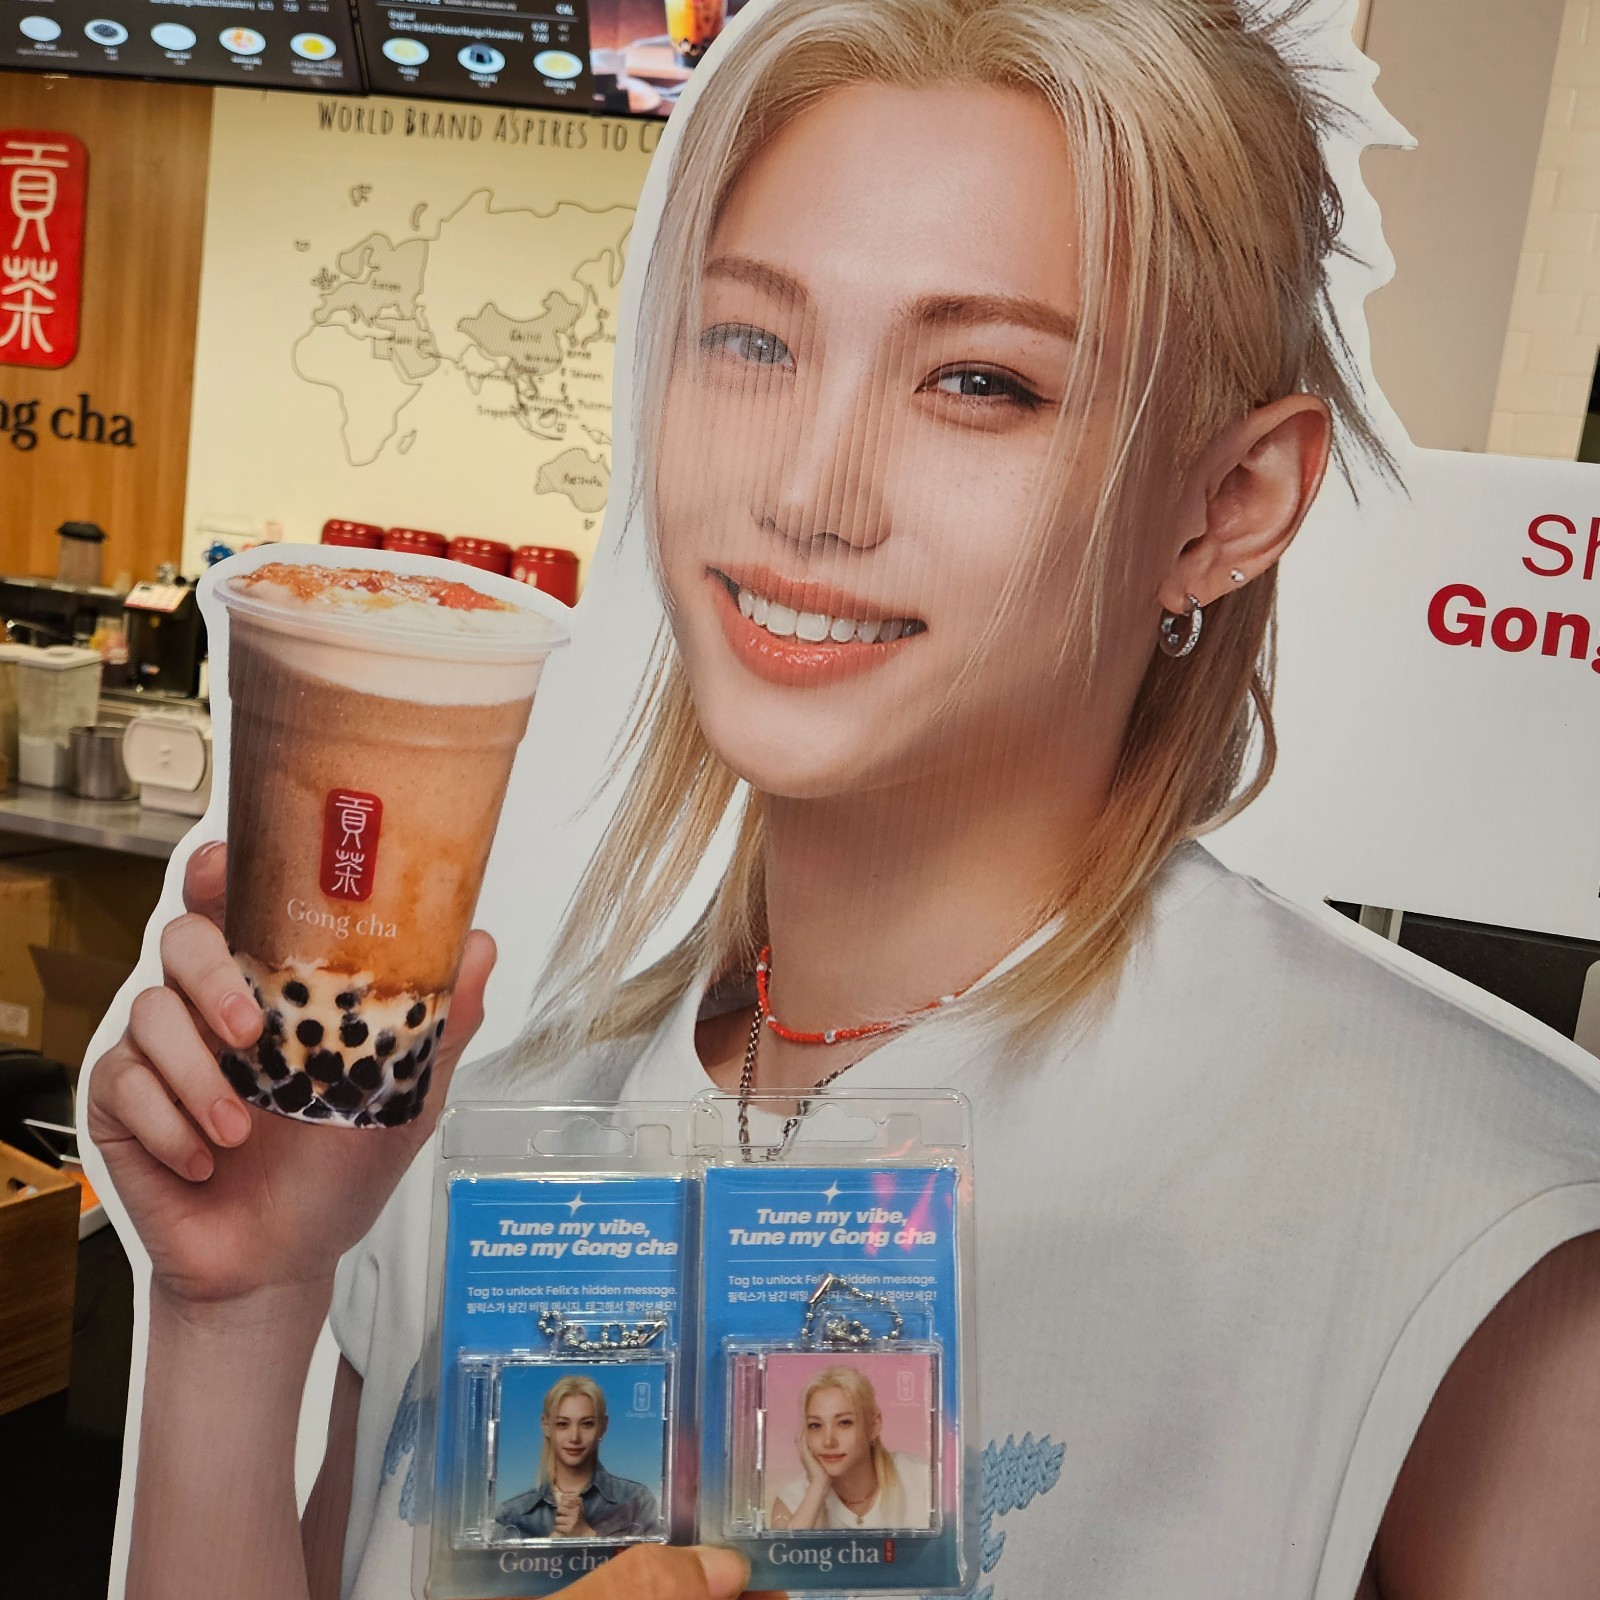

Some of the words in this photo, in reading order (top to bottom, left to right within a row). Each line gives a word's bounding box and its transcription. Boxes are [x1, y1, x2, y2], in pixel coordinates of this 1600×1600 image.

[318, 100, 394, 136] WORLD
[403, 106, 482, 142] BRAND
[495, 112, 588, 150] ASPIRES
[601, 122, 628, 152] TO
[51, 393, 136, 447] cha
[331, 795, 374, 896] 貢茶
[287, 897, 351, 940] Gong
[356, 913, 398, 939] cha
[499, 1219, 554, 1235] Tune
[558, 1222, 595, 1238] my
[599, 1218, 650, 1238] vibe,
[757, 1208, 812, 1224] Tune
[815, 1211, 852, 1227] my
[856, 1207, 908, 1226] vibe,
[470, 1240, 528, 1257] Tune
[530, 1242, 569, 1259] my
[572, 1239, 632, 1259] Gong
[635, 1239, 679, 1256] cha
[729, 1229, 785, 1245] Tune
[788, 1231, 826, 1247] my
[829, 1228, 890, 1247] Gong
[894, 1228, 936, 1245] cha
[467, 1286, 489, 1299] Tag
[492, 1286, 503, 1296] to
[506, 1285, 543, 1296] unlock
[546, 1285, 579, 1296] Felix's
[582, 1284, 621, 1295] hidden
[624, 1286, 678, 1298] message.
[728, 1275, 749, 1288] Tag
[752, 1275, 763, 1285] to
[766, 1274, 804, 1285] unlock
[882, 1275, 938, 1287] message.
[499, 1551, 563, 1579] Gong
[768, 1543, 833, 1572] Gong
[838, 1541, 880, 1564] cha
